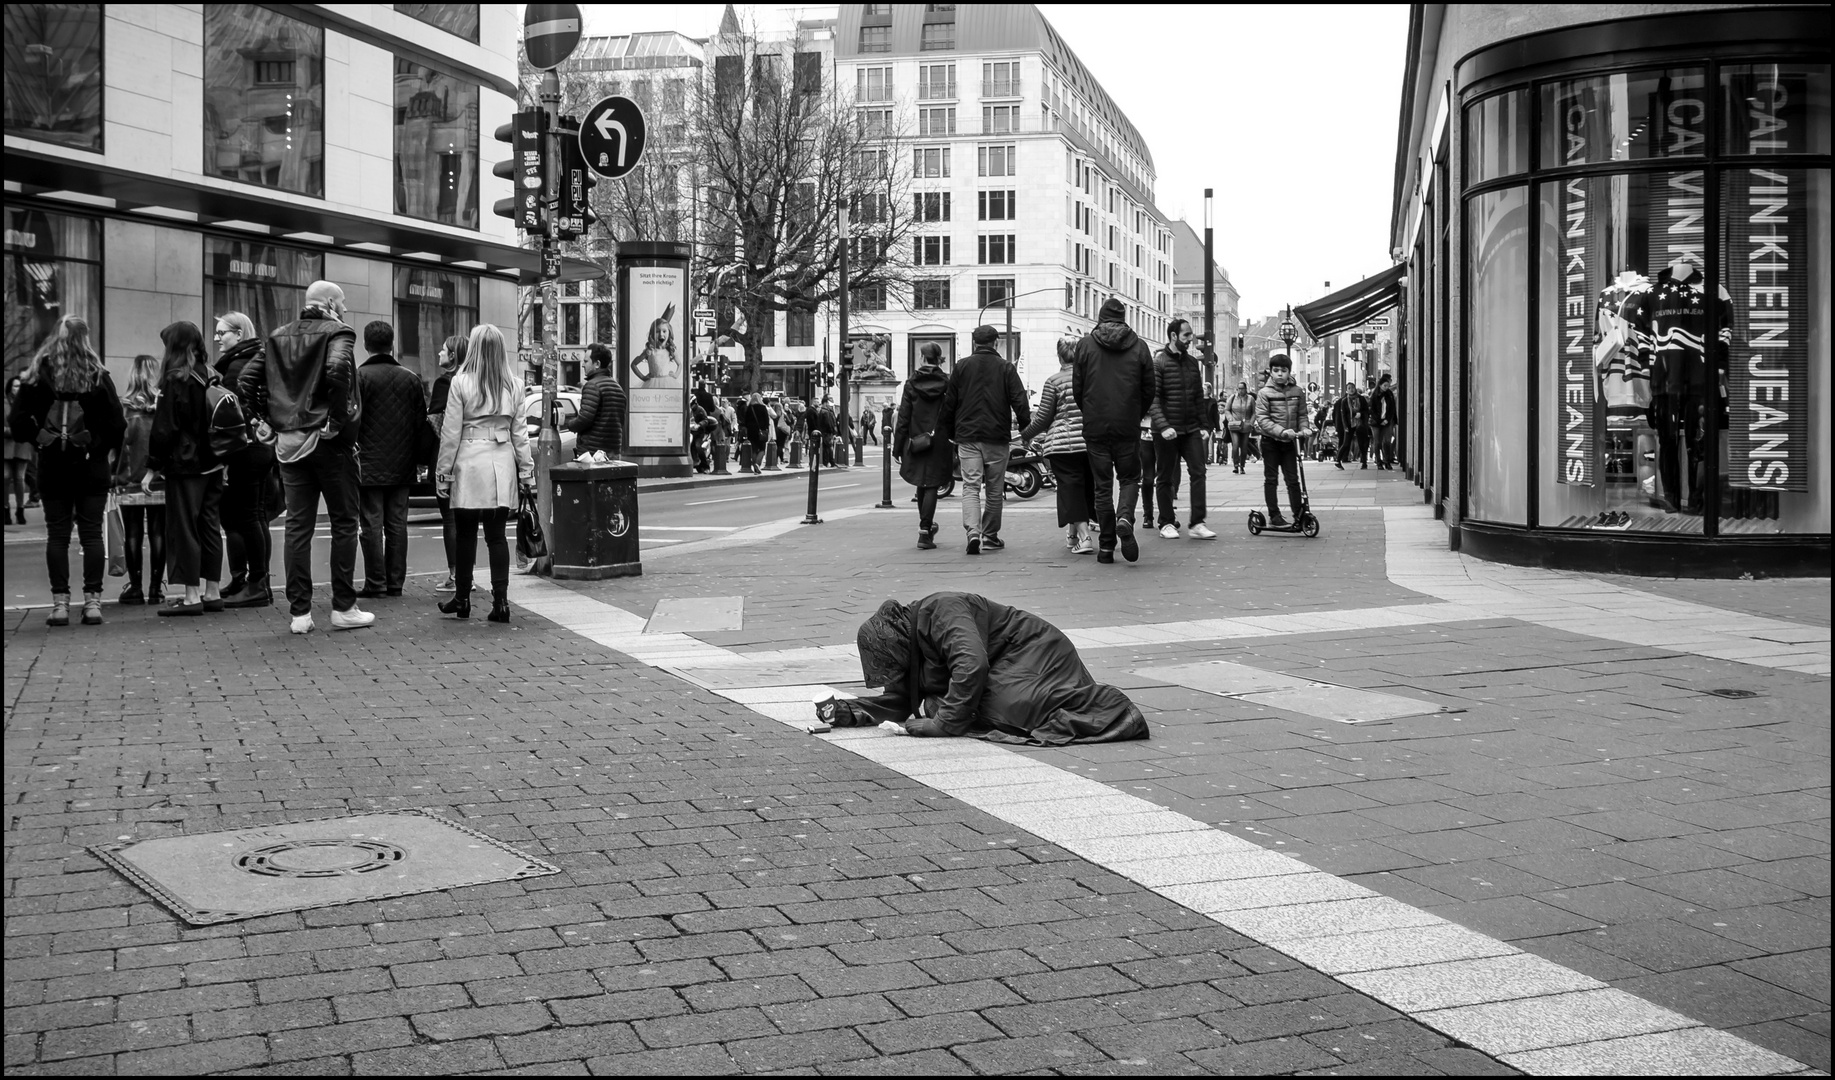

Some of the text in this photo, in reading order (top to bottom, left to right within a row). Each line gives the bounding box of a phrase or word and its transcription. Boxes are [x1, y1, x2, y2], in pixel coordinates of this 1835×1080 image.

[1566, 247, 1585, 355] KLEIN
[1749, 236, 1789, 347] KLEIN
[1566, 360, 1585, 483] JEANS
[1748, 354, 1789, 485] JEANS
